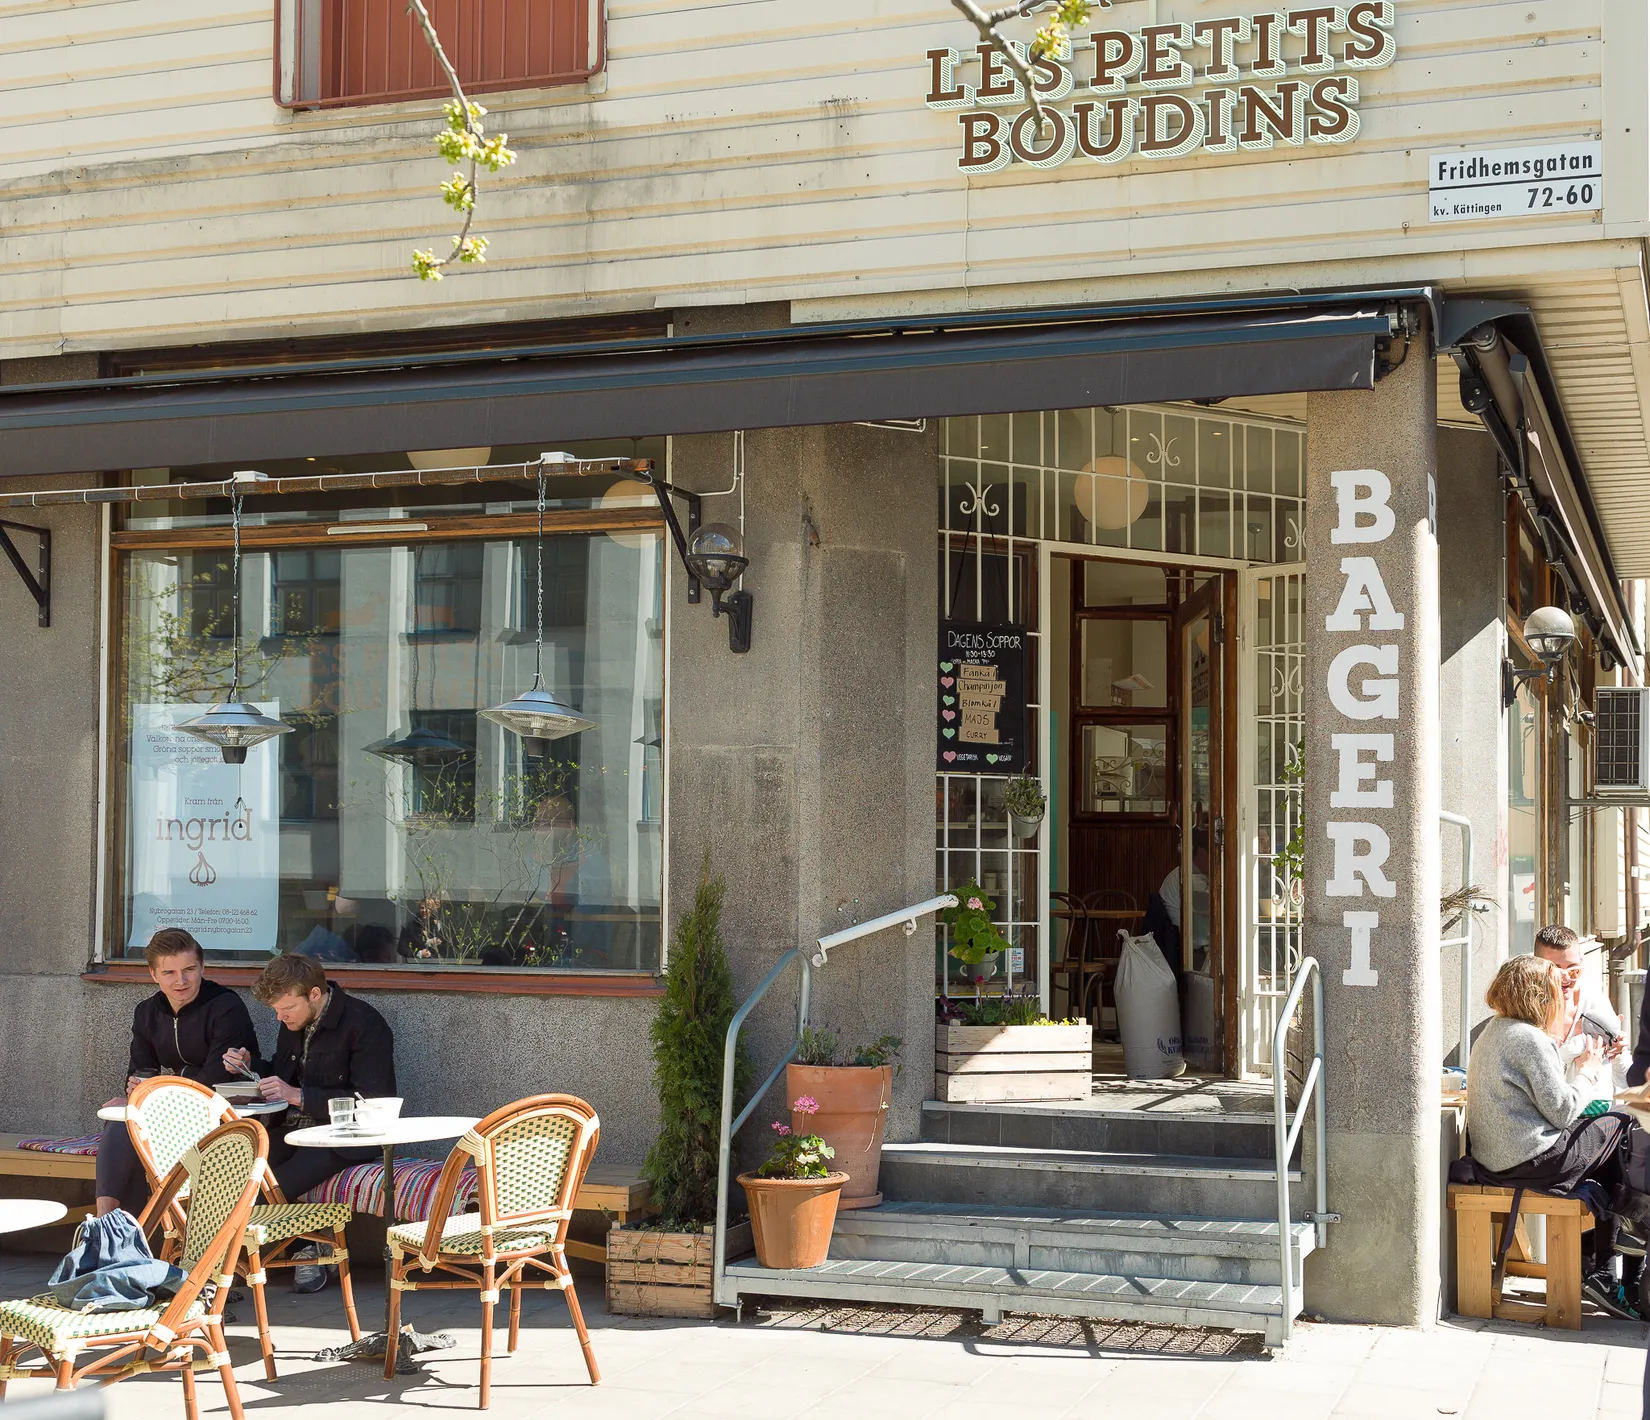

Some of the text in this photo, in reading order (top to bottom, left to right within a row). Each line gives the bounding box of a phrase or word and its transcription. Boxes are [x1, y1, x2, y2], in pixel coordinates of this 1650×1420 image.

[926, 1, 1396, 110] LES PETITS
[957, 75, 1360, 174] BOUDINS
[1438, 154, 1593, 181] Fridhemsgatan
[1527, 184, 1593, 208] 72-60
[1433, 203, 1502, 216] kv. Kättingen
[947, 630, 1022, 649] DAGENS SOPPOR
[958, 679, 1003, 693] Champinjon
[1325, 469, 1405, 986] BAGERI
[184, 797, 224, 805] Kram från
[156, 808, 253, 850] ingrid
